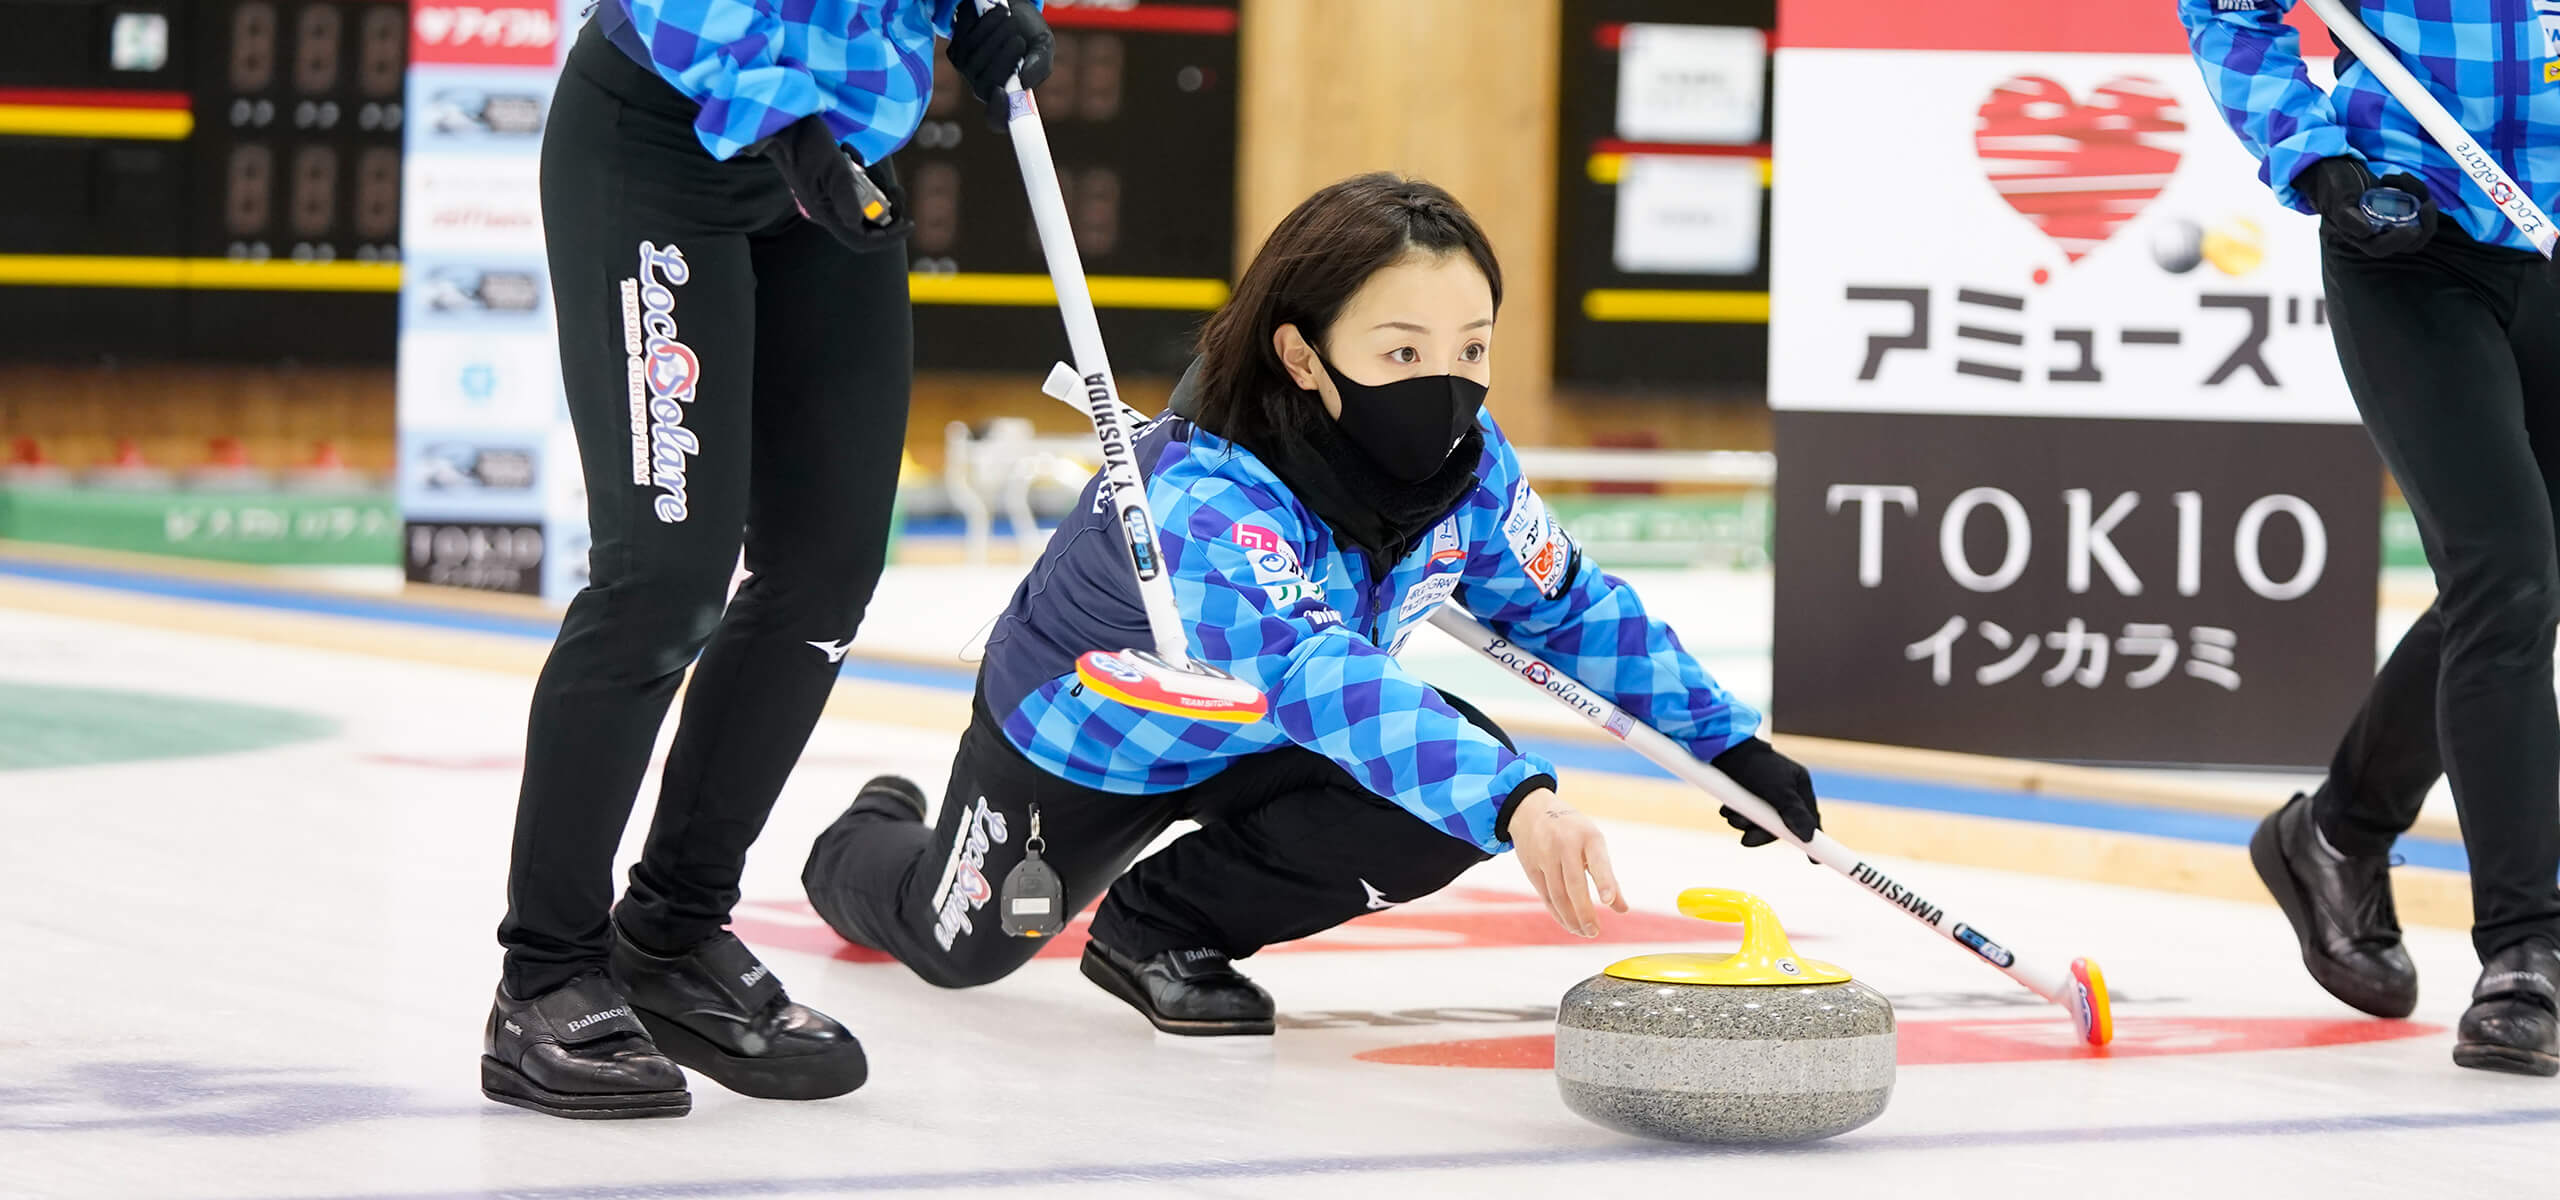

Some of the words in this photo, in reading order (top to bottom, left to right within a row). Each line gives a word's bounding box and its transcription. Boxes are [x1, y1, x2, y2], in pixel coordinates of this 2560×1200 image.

[1846, 286, 2327, 387] アミューズ
[1084, 372, 1130, 472] YOSHIDA
[1112, 475, 1135, 493] Y.
[1826, 484, 2328, 600] TOKIO
[1905, 615, 2241, 691] インカラミ
[1849, 862, 1944, 926] FUJISAWA
